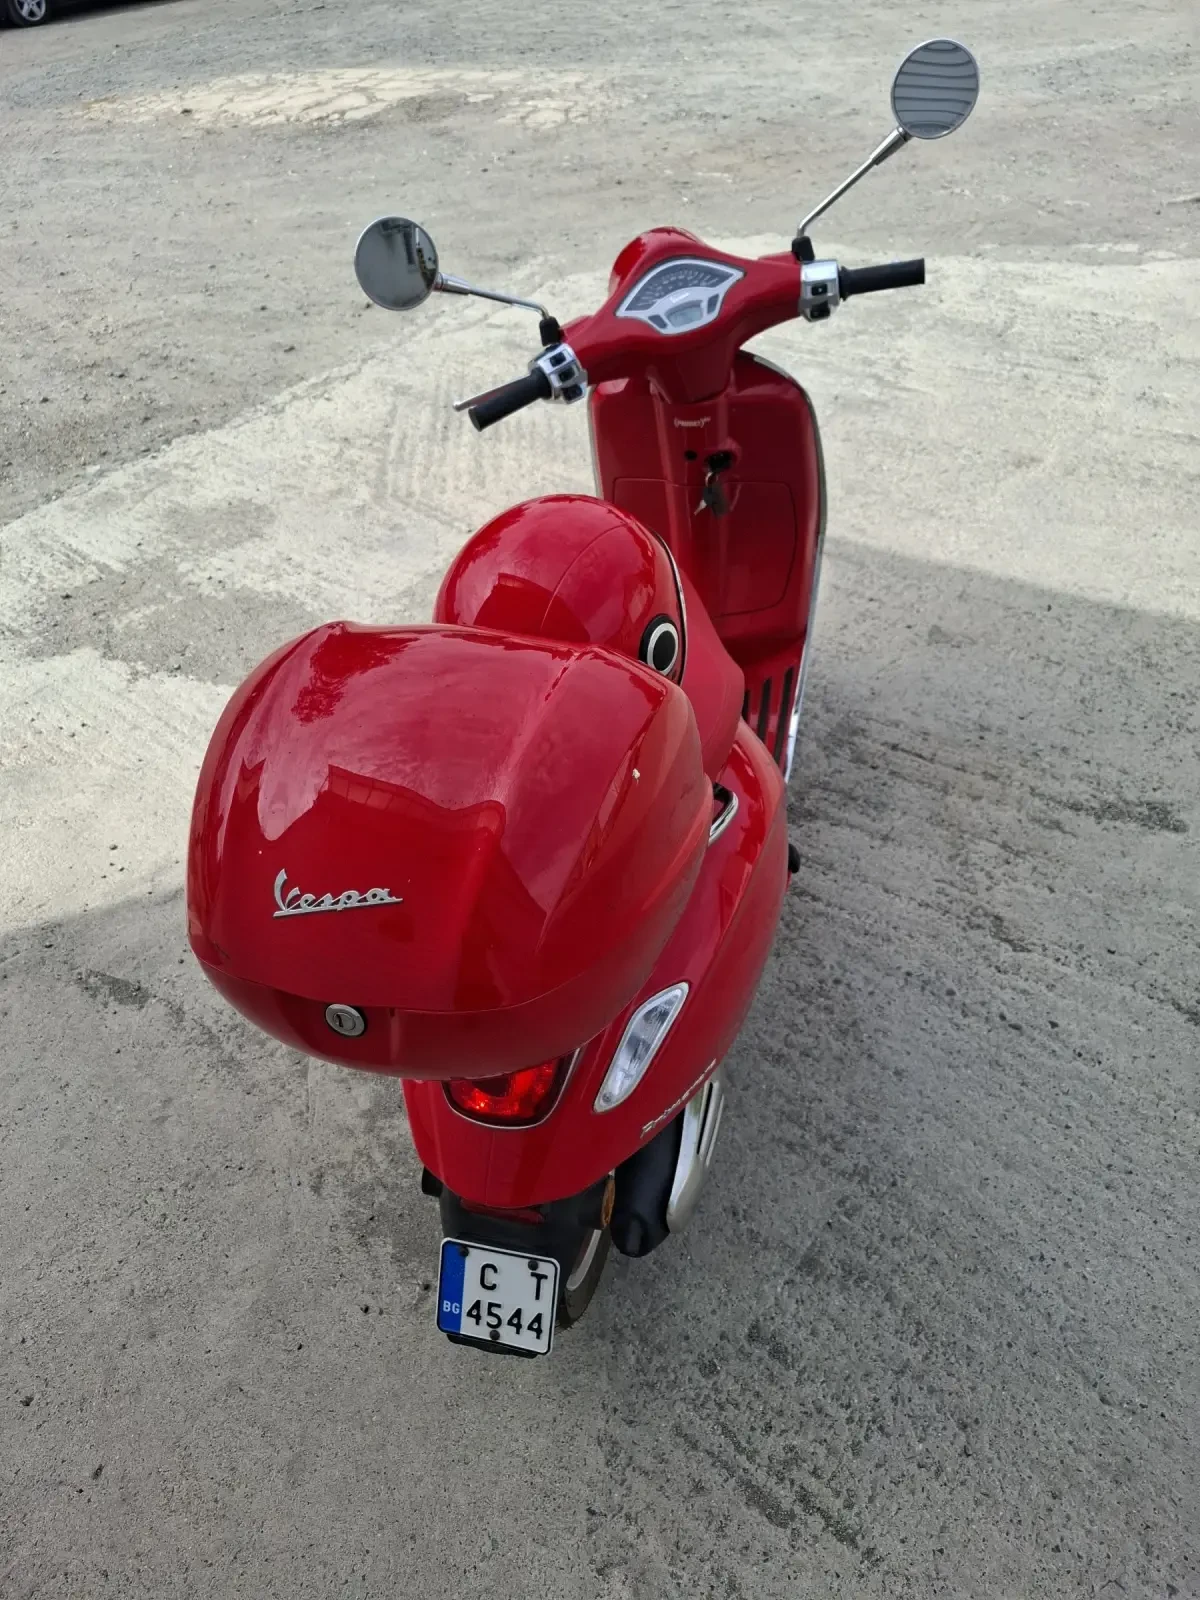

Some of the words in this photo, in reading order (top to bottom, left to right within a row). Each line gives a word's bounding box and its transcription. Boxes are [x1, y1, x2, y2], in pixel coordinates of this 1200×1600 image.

[273, 868, 403, 917] Vespa
[480, 1263, 498, 1290] C
[530, 1272, 548, 1300] T
[443, 1300, 460, 1314] BG
[466, 1299, 543, 1340] 4544
